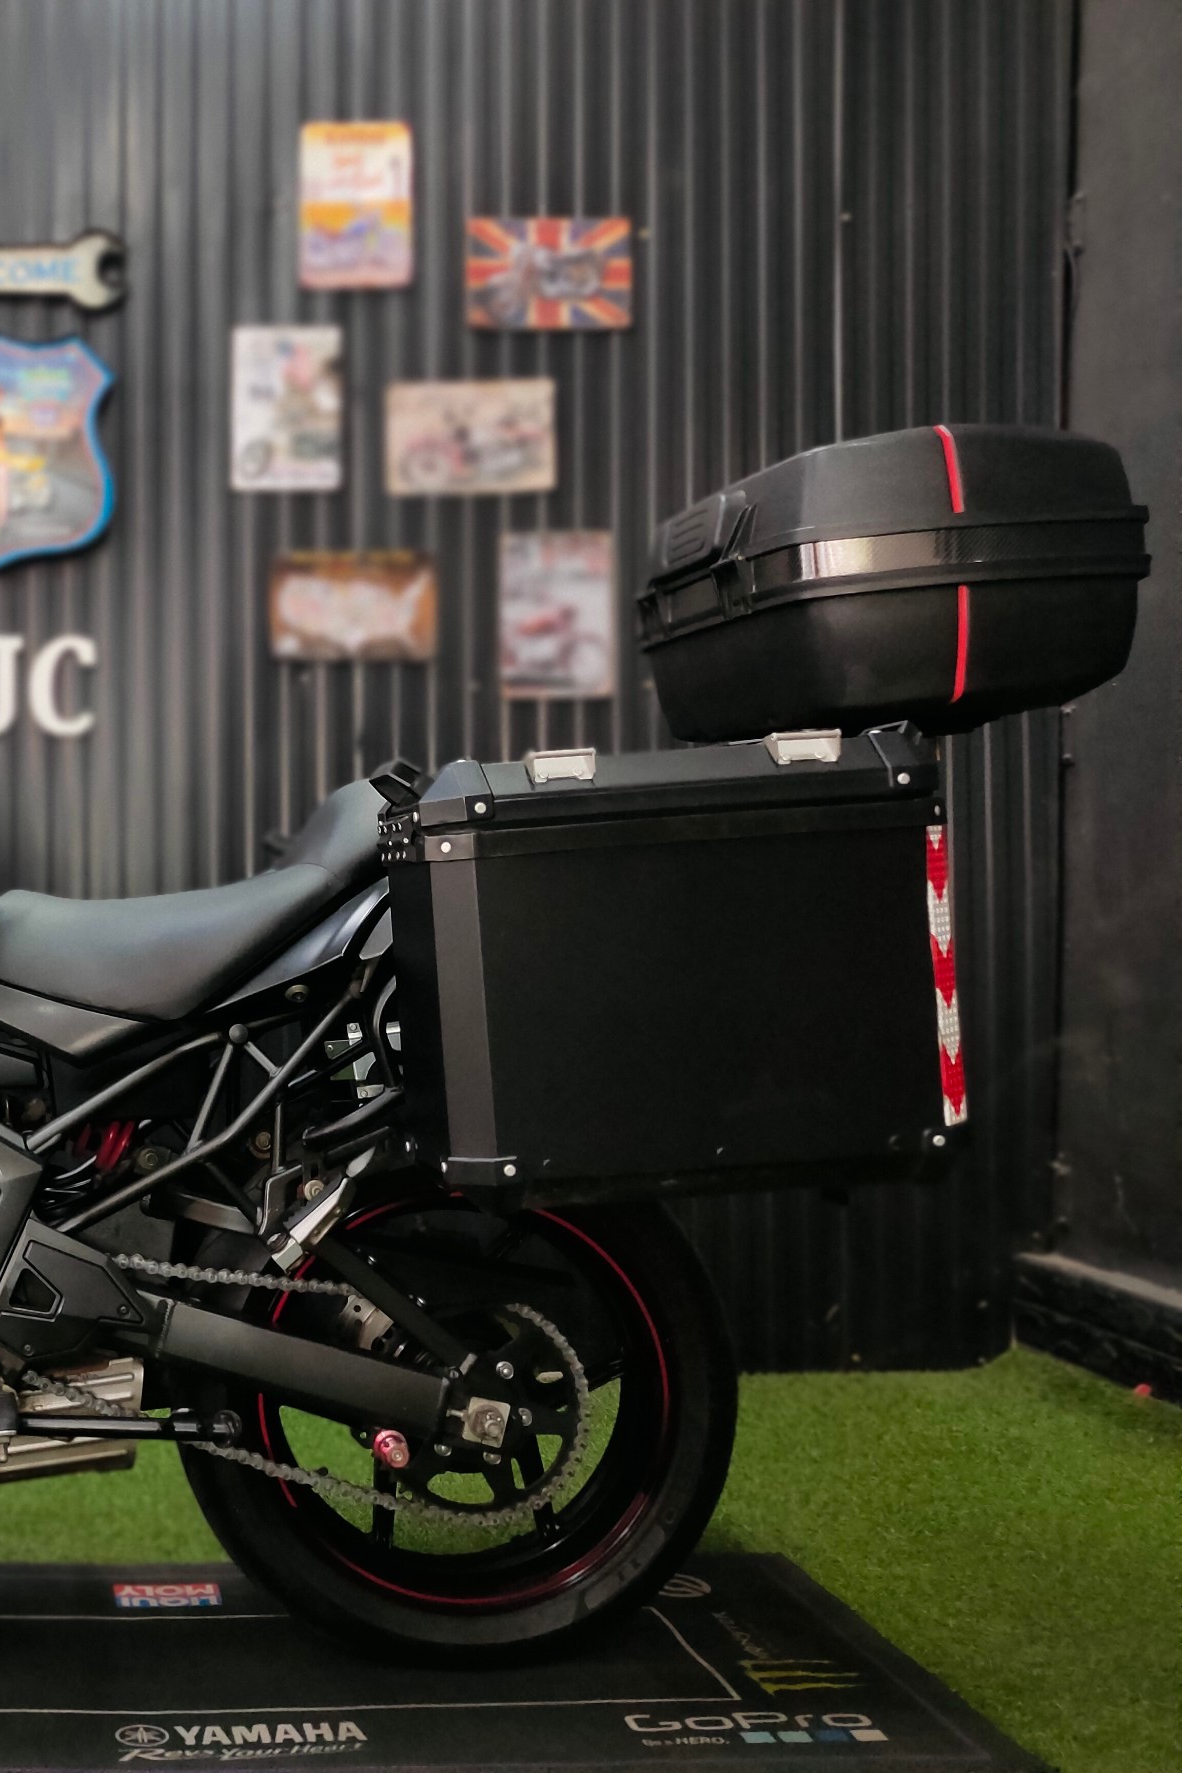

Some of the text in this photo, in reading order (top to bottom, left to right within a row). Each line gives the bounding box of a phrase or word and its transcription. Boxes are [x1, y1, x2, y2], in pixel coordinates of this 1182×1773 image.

[120, 1584, 215, 1597] MOLY
[121, 1596, 221, 1607] LIQUI
[624, 1711, 873, 1732] GoPro
[173, 1721, 368, 1746] YAMAHA
